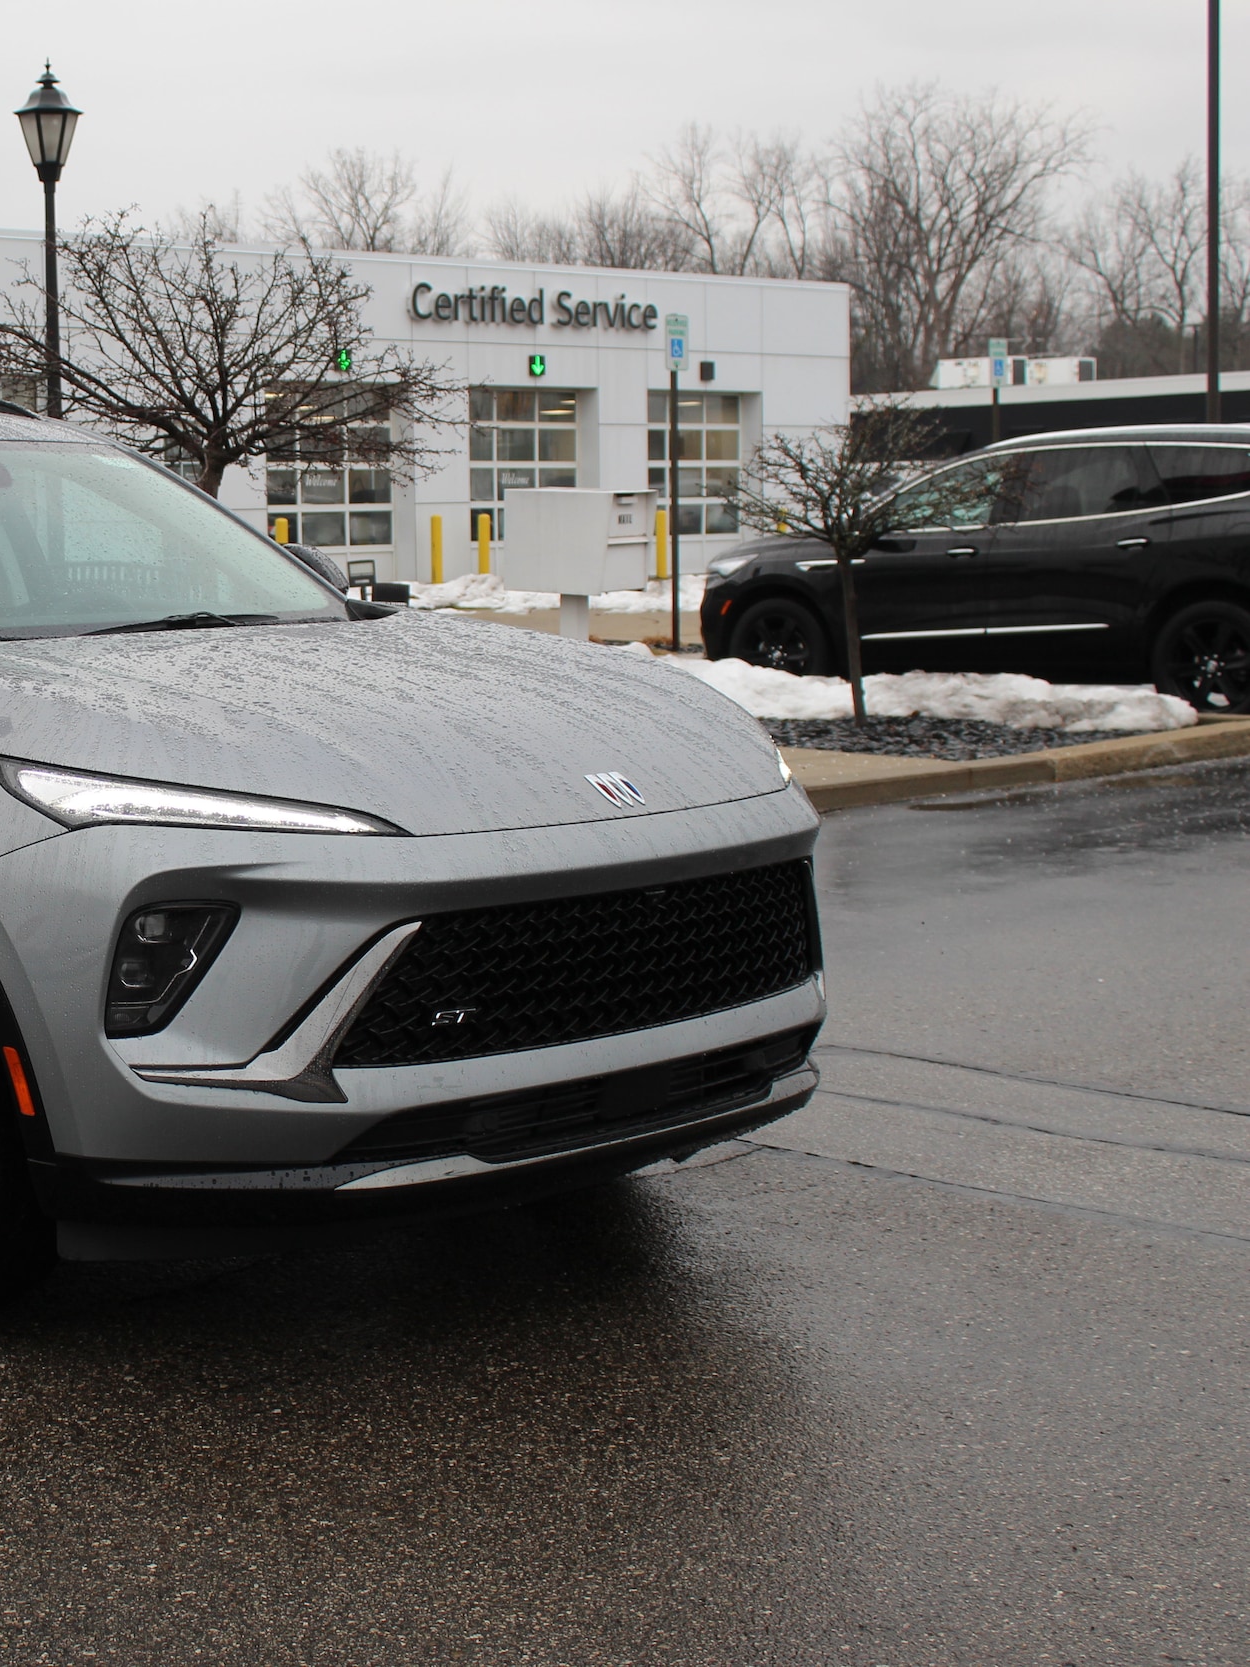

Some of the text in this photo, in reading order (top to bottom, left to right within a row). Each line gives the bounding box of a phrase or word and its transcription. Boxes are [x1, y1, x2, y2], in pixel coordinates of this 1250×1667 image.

[411, 282, 658, 330] Certified Service
[305, 473, 338, 487] Welcome
[502, 472, 530, 485] Welcome
[431, 1008, 477, 1025] ST
